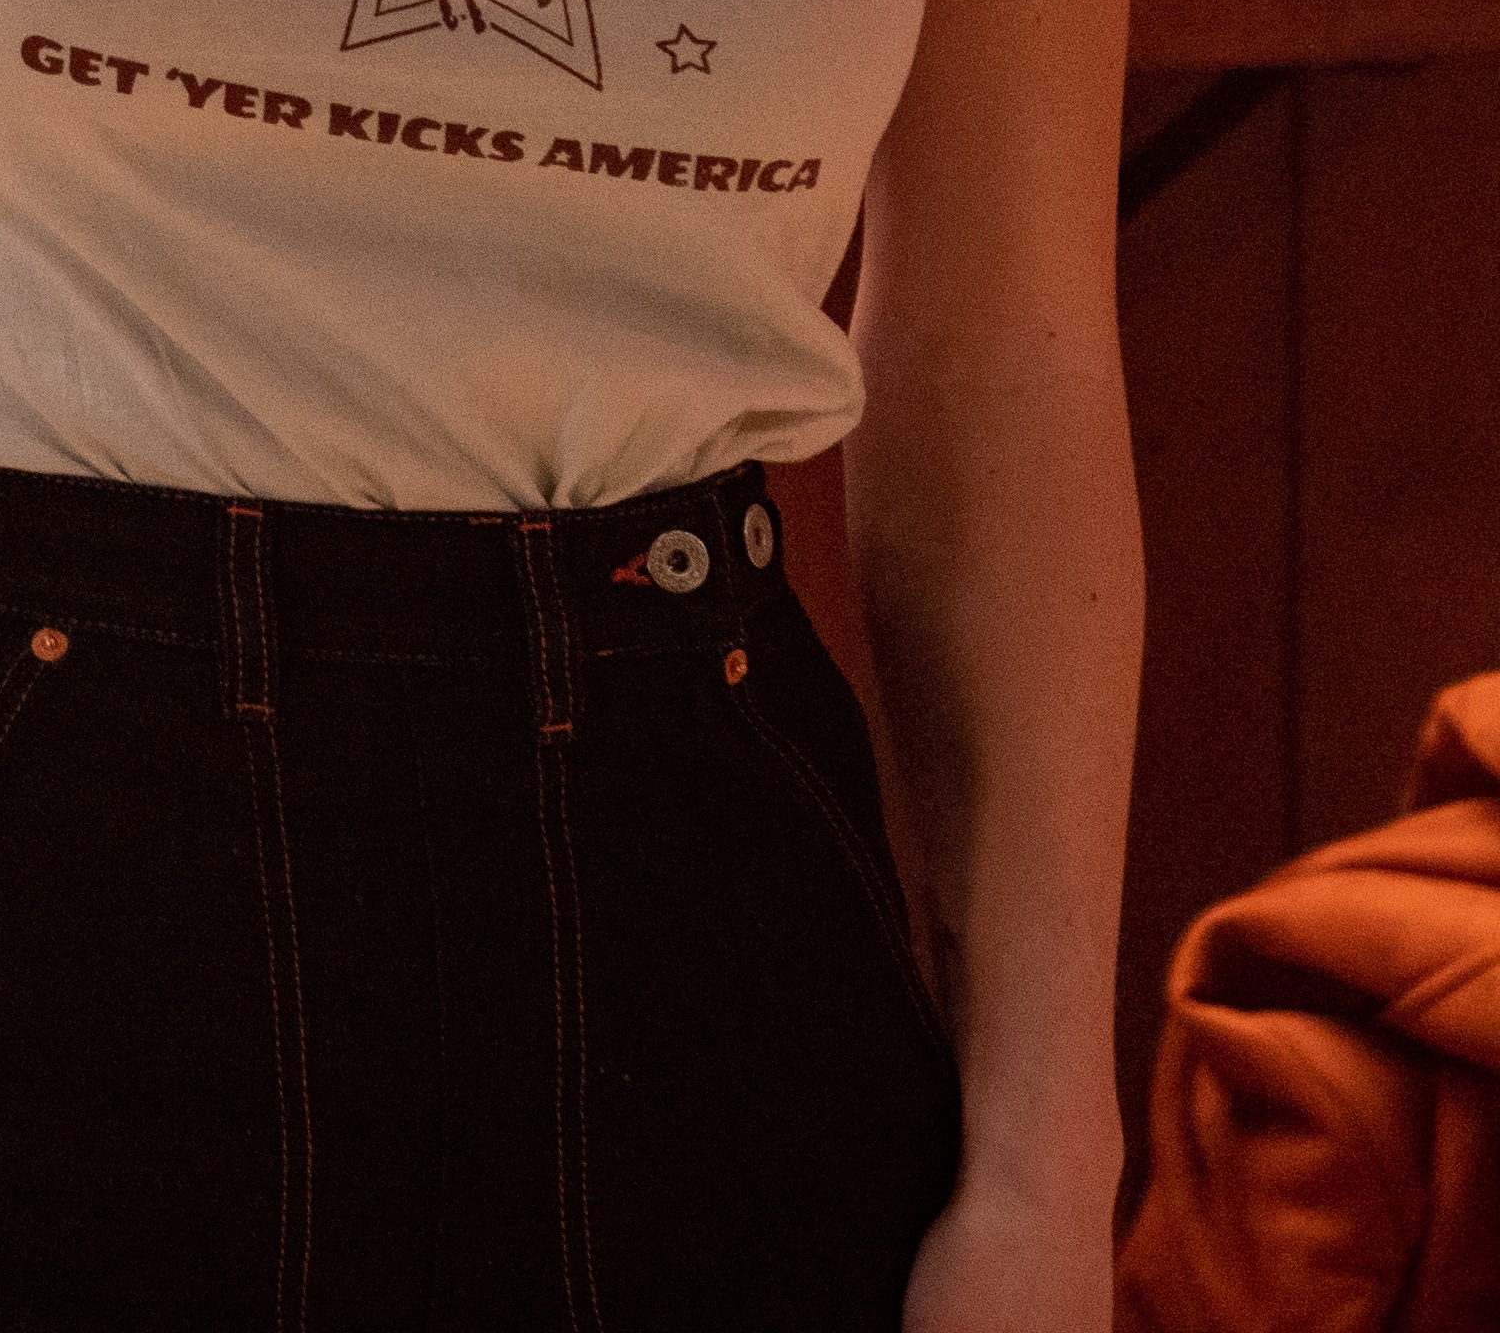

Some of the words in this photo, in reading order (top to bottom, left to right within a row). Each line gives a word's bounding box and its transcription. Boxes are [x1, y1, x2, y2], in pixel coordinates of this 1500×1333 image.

[20, 35, 150, 95] GET
[328, 102, 526, 164] KICKS
[537, 137, 823, 193] AMERICA
